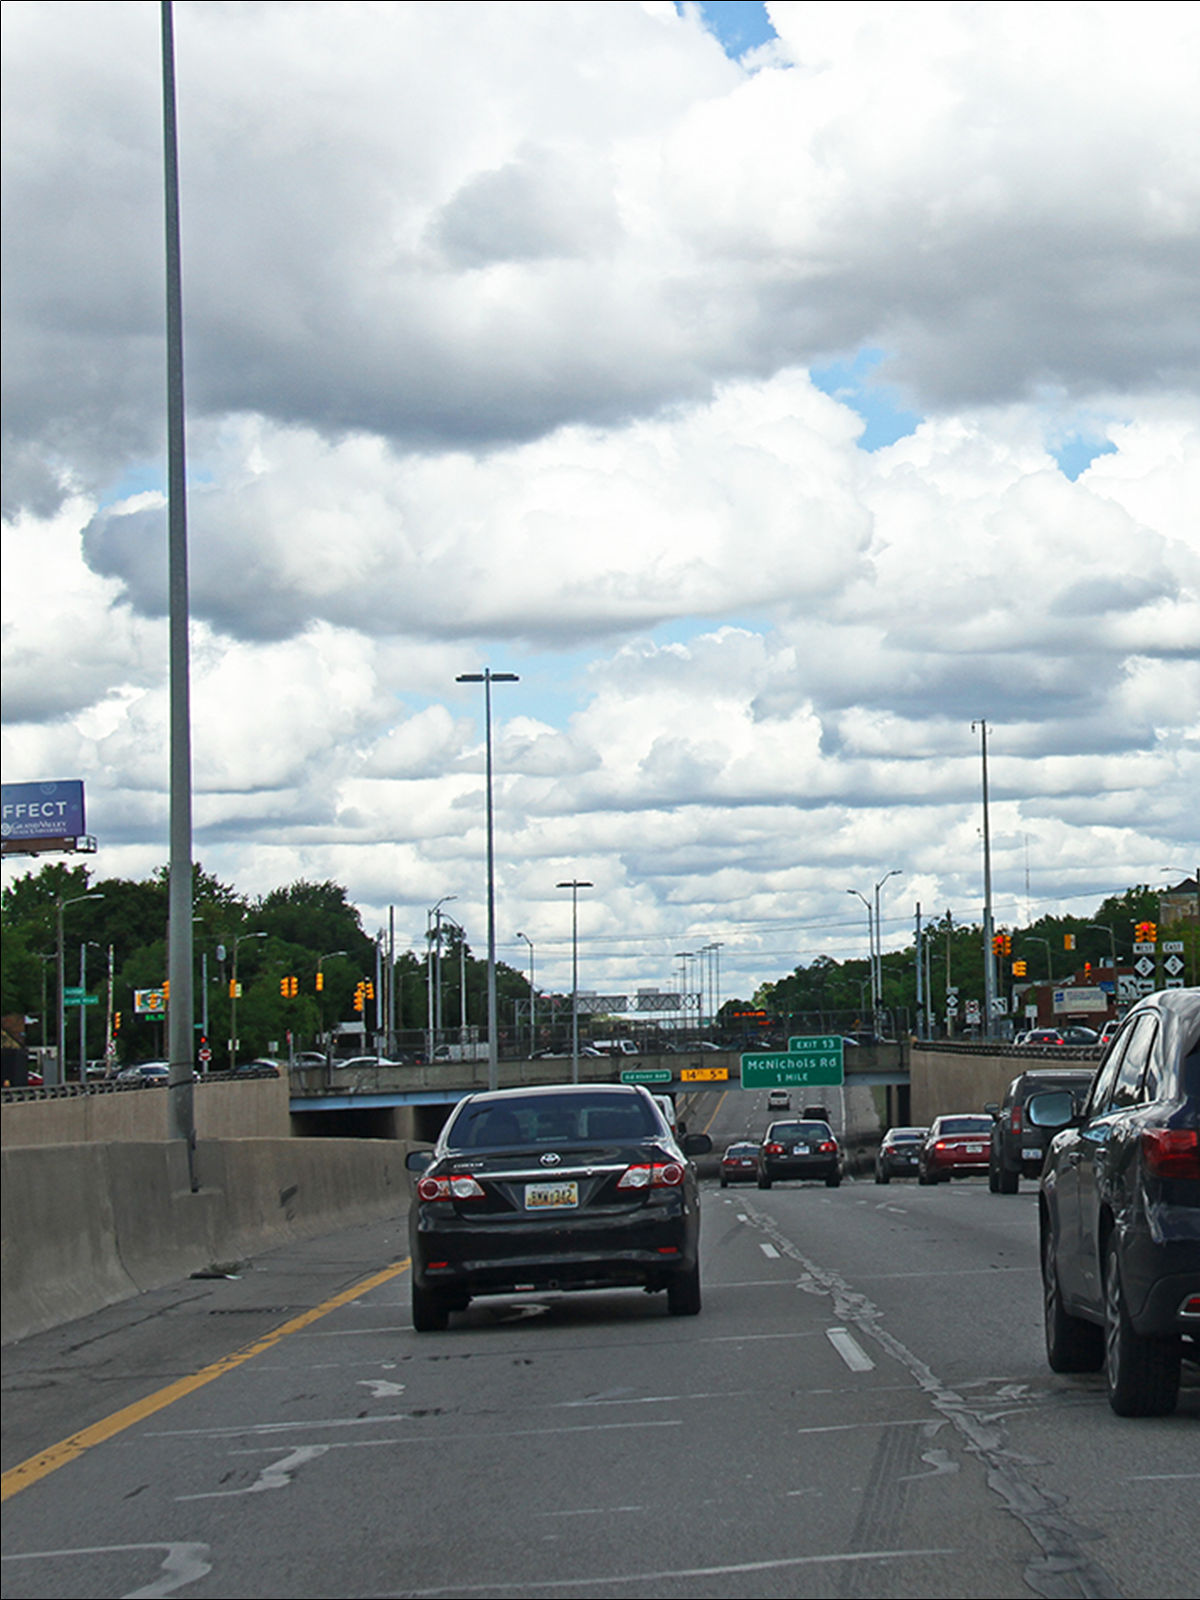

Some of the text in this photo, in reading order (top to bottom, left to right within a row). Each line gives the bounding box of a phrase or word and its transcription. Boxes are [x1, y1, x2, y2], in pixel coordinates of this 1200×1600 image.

[2, 801, 67, 819] FFECT
[796, 1039, 834, 1049] EXIT 13
[747, 1057, 837, 1070] McNichols Rd
[686, 1071, 697, 1079] 14
[785, 1073, 808, 1081] MILE
